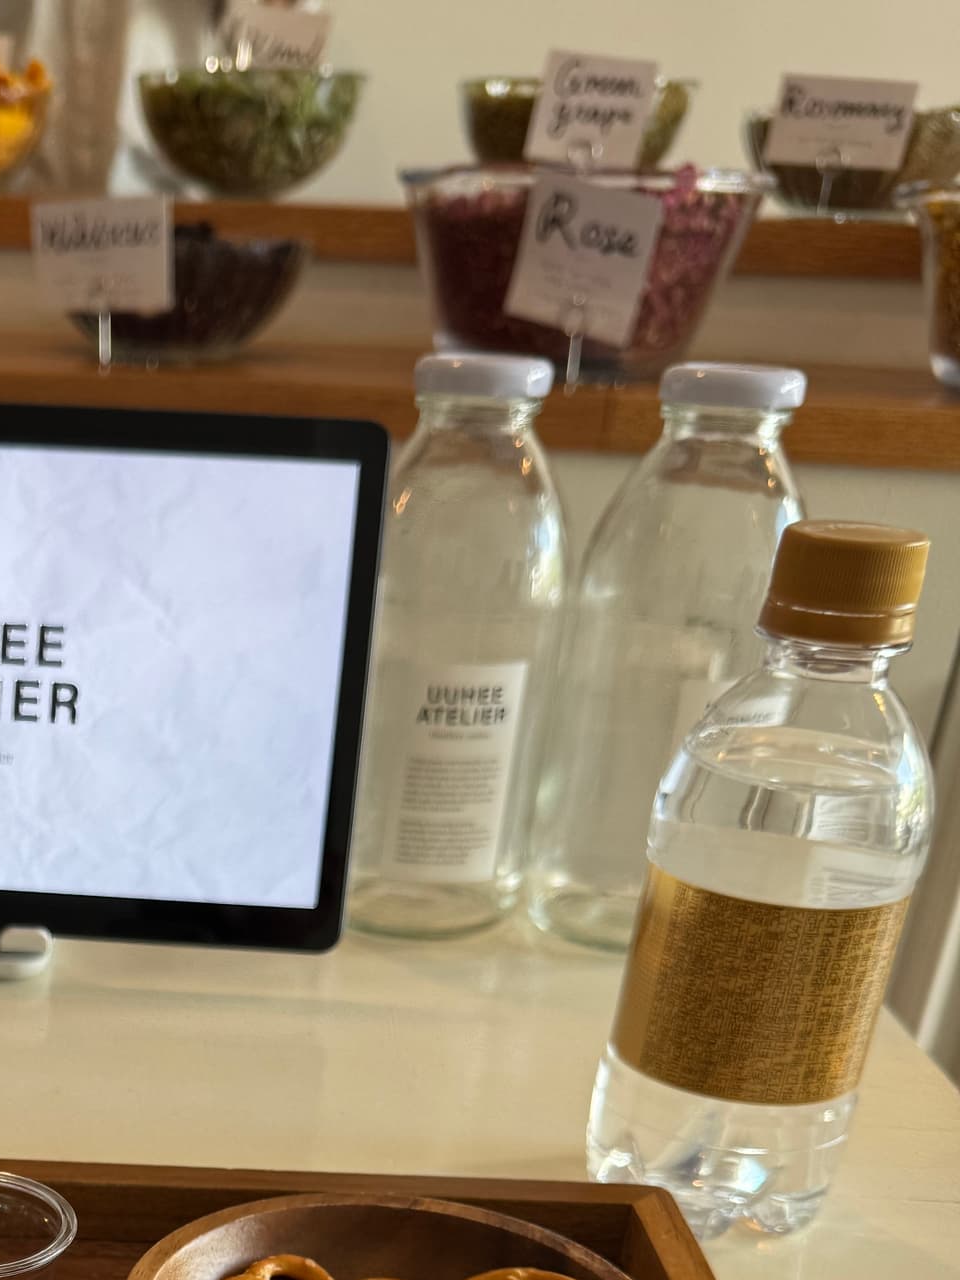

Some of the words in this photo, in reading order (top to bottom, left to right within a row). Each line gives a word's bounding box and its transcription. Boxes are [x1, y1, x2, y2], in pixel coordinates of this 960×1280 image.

[536, 192, 640, 258] Rose
[426, 684, 506, 706] UUHEE
[415, 705, 507, 727] ATELIER
